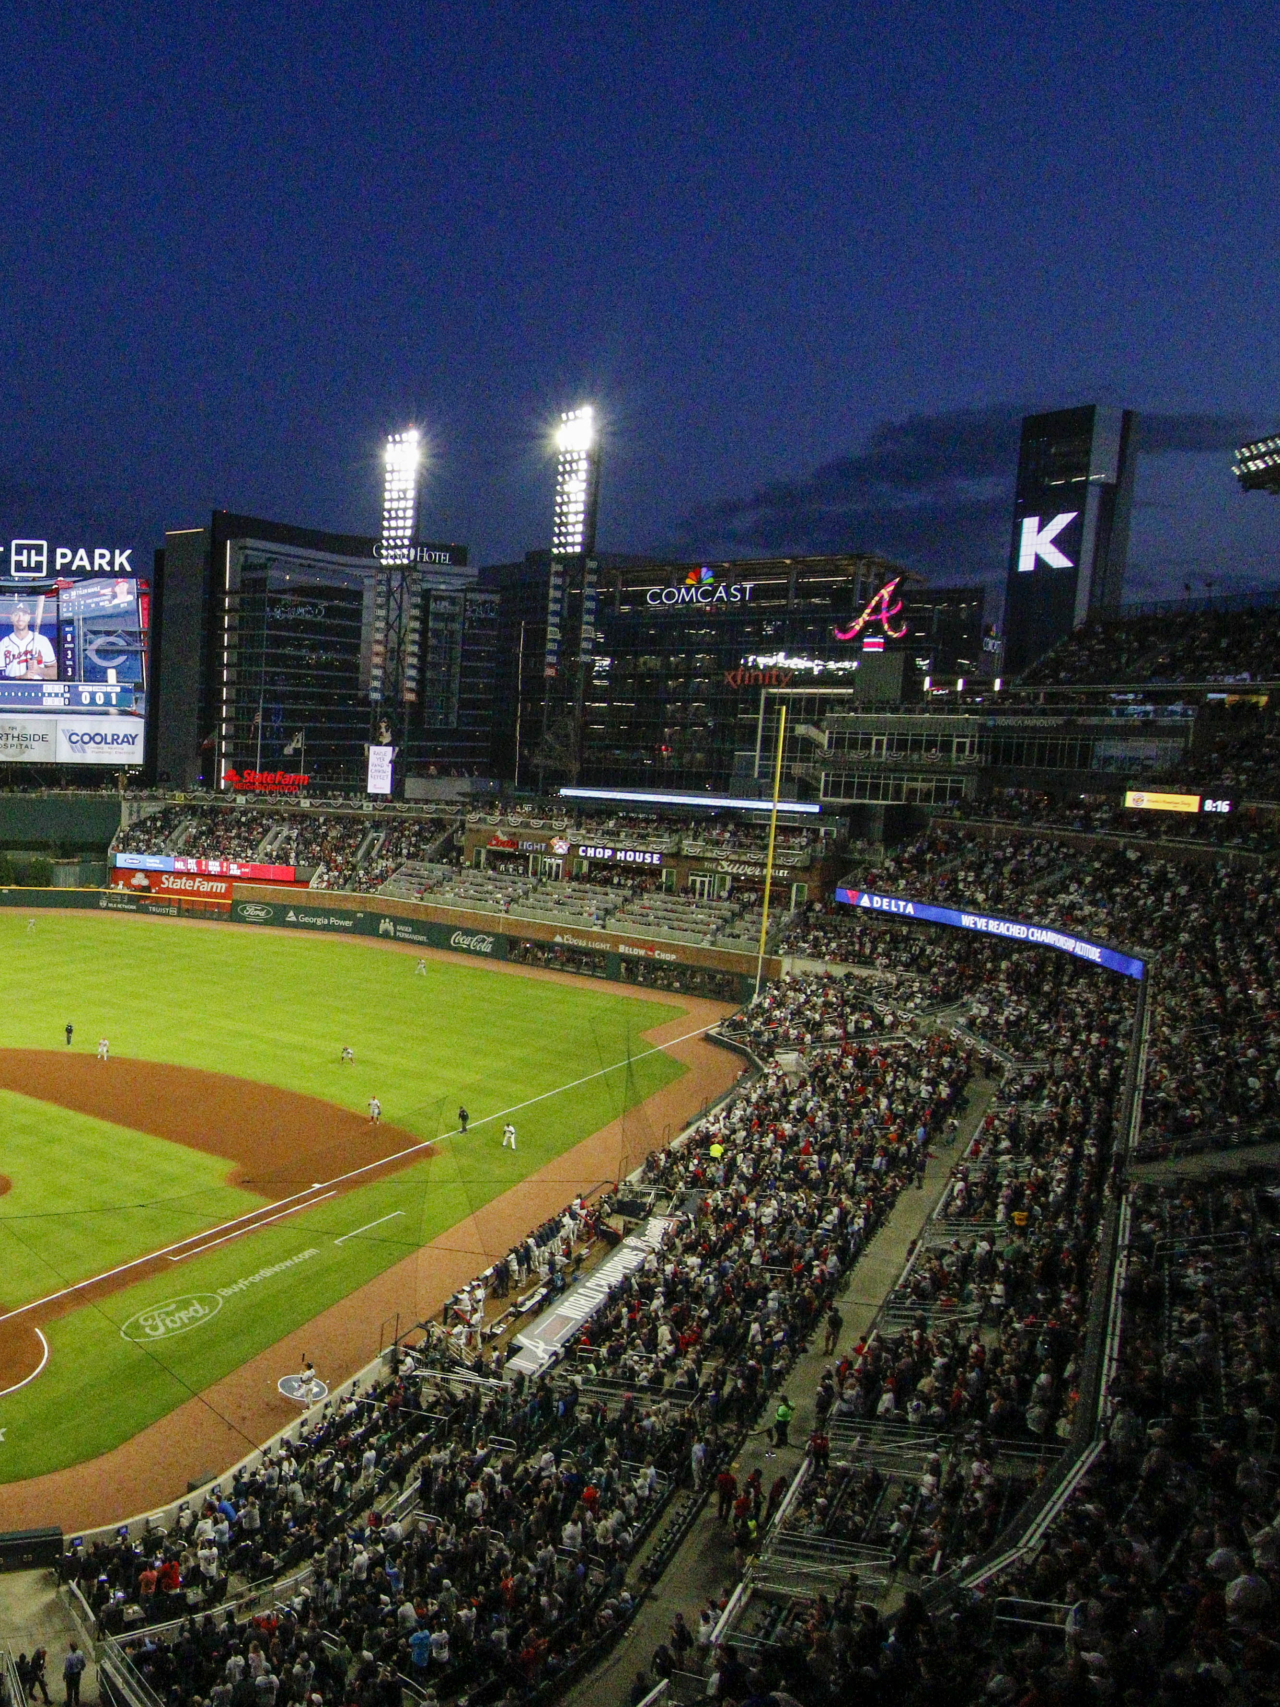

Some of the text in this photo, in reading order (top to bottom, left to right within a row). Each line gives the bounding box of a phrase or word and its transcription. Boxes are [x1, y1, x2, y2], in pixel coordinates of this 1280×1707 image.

[1018, 511, 1079, 572] K
[55, 548, 133, 571] PARK
[417, 546, 452, 564] HOTEL
[646, 584, 754, 605] COMCAST
[834, 577, 908, 640] A
[724, 666, 793, 689] xfinity
[81, 692, 117, 705] 0 0 1
[68, 732, 139, 746] COOLRAY
[233, 782, 299, 793] NEIGHBORHOOD
[1204, 799, 1231, 812] 8:16
[518, 842, 547, 852] LIGHT
[578, 846, 661, 864] CHOP HOUSE
[174, 861, 185, 869] NL
[718, 860, 762, 876] Silver
[149, 906, 169, 914] TRUIST
[244, 906, 267, 917] Ford
[873, 895, 914, 915] DELTA
[961, 914, 988, 931] WE'VE
[988, 920, 1028, 938] REACHED
[298, 914, 353, 927] Georgia Power
[397, 925, 412, 933] KAISER
[450, 930, 495, 952] Coca-Cola
[588, 941, 611, 950] LIGHT
[619, 944, 677, 961] BELOW CHOP
[217, 1248, 320, 1297] BuyFordNow.com
[555, 1248, 646, 1320] WORLD CHAMPIONS
[139, 1300, 210, 1336] Ford
